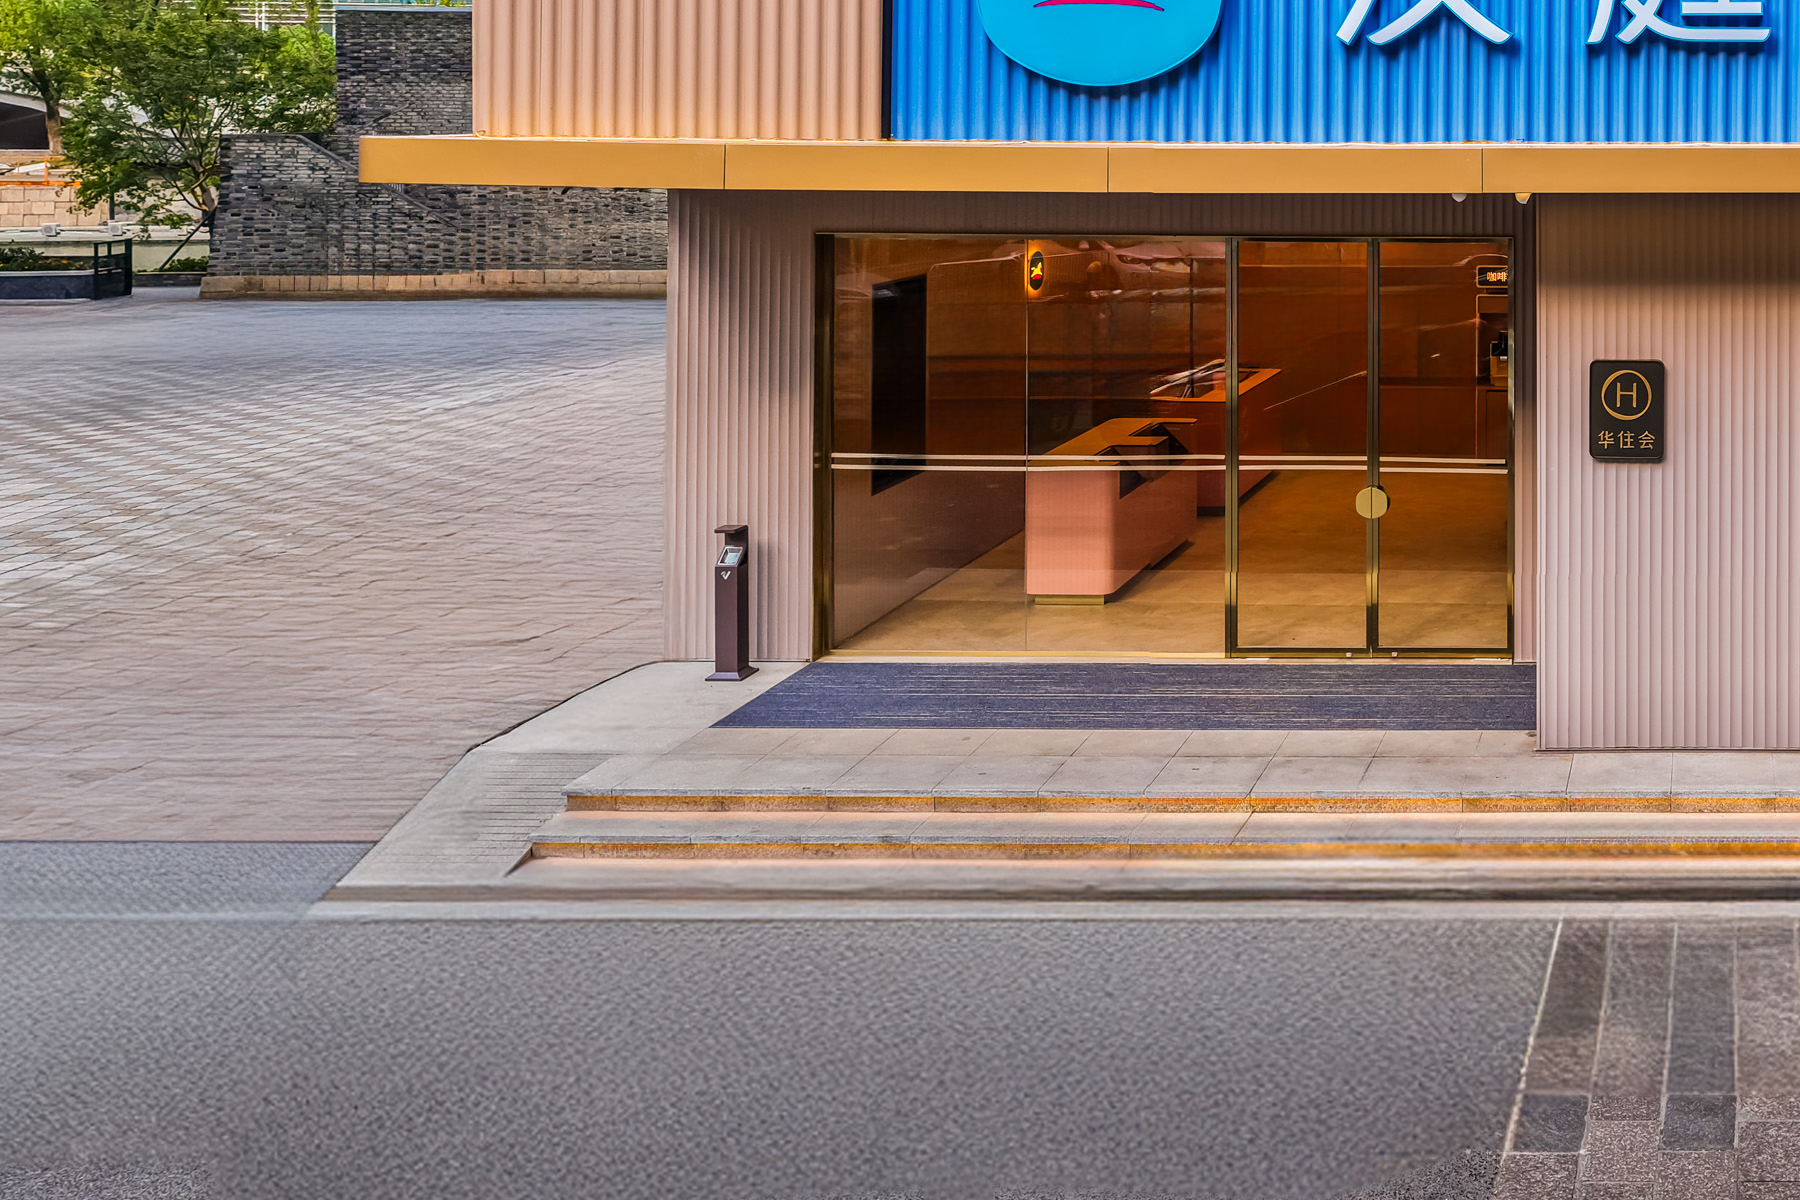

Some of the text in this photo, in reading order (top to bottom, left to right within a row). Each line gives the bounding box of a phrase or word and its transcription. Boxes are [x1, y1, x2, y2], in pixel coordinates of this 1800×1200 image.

[1616, 382, 1637, 408] H
[1597, 430, 1656, 450] 华住会
